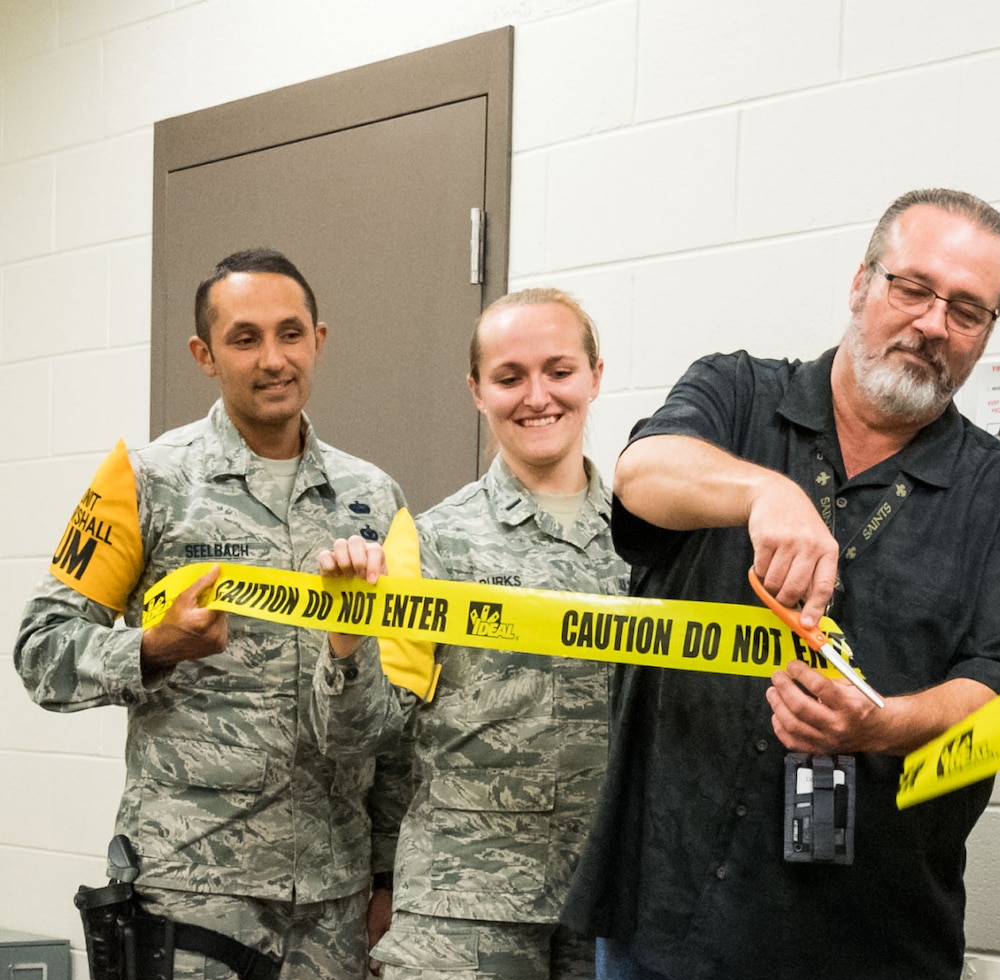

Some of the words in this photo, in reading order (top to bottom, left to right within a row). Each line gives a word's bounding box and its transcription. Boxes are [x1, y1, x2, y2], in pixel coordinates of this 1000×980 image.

[74, 506, 112, 545] SHALL
[862, 502, 892, 540] SAINTS
[185, 543, 249, 558] SEELBACH
[214, 580, 299, 615] CAUTION
[302, 589, 333, 620] DO
[337, 590, 377, 625] NOT
[382, 593, 449, 632] ENTER
[471, 617, 516, 640] IDEAL
[561, 610, 673, 656] CAUTION
[682, 621, 722, 660] DO
[732, 624, 782, 667] NOT
